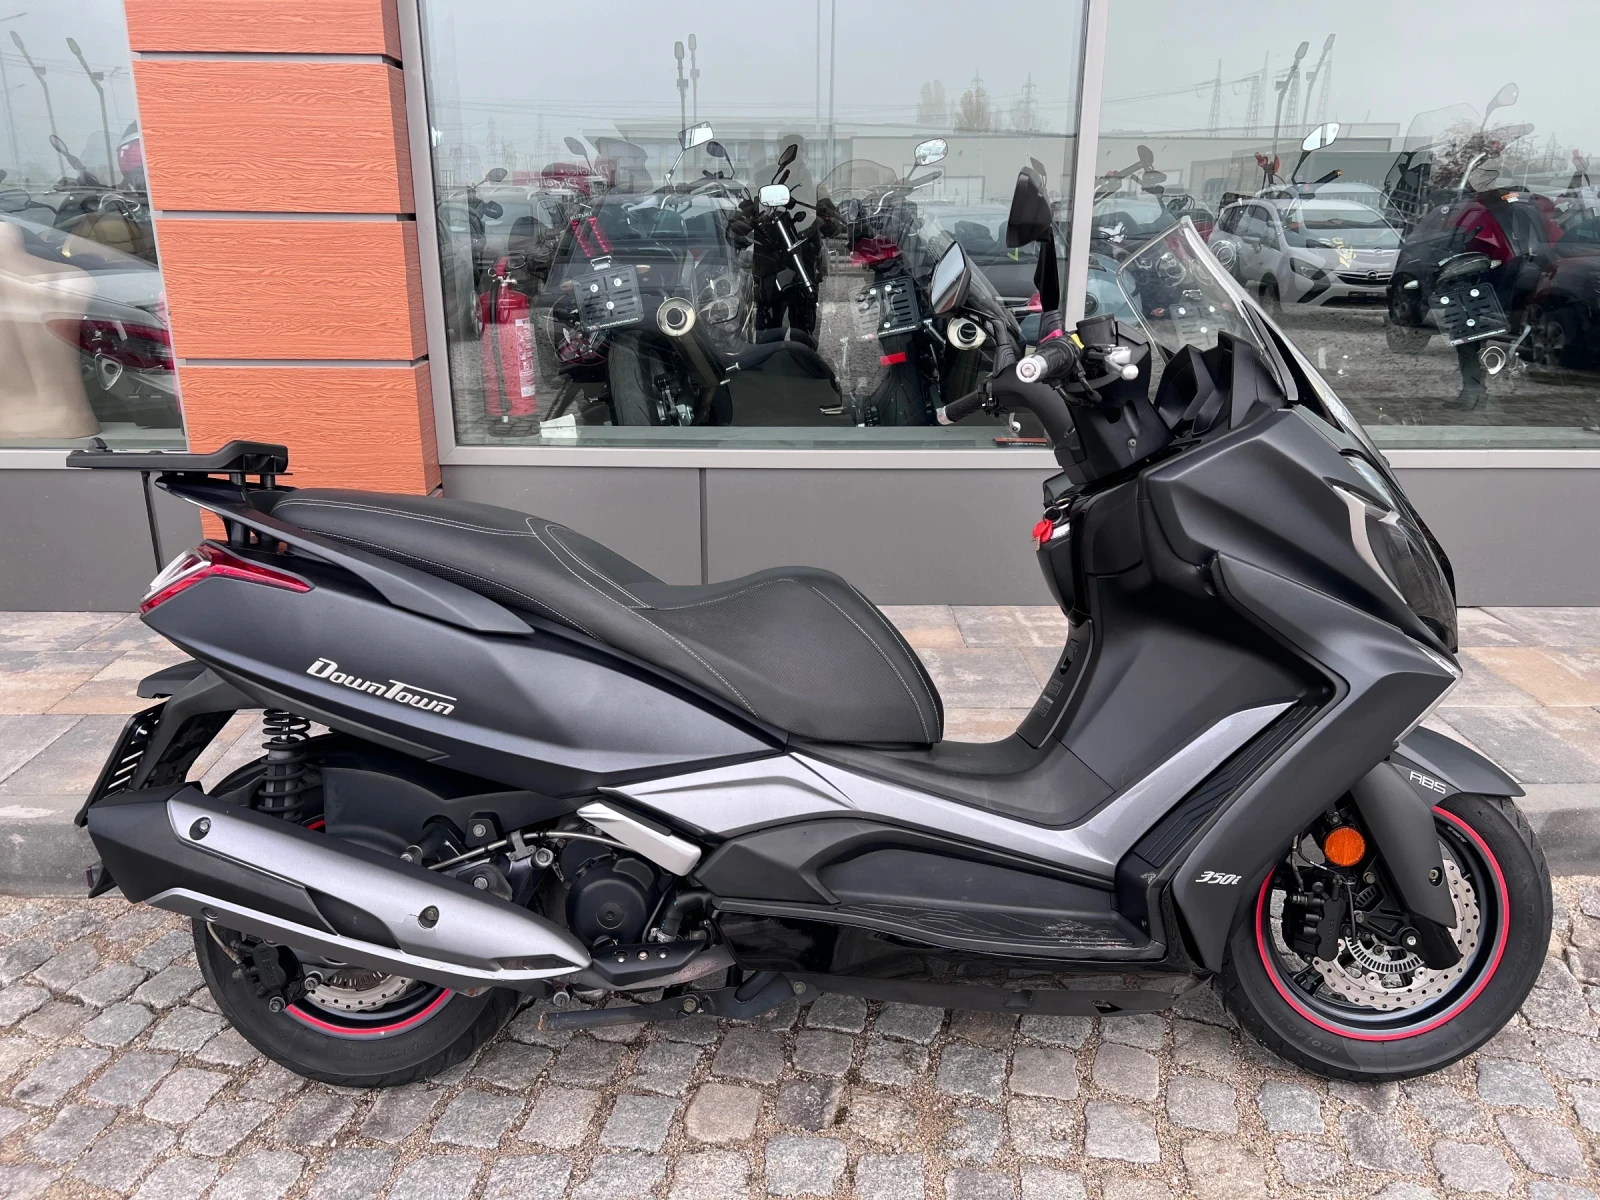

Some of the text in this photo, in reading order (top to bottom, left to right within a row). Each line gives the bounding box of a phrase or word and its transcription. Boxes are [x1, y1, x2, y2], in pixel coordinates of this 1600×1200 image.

[306, 657, 457, 715] DownTown
[1410, 771, 1446, 794] ABS
[1195, 871, 1242, 885] 350i
